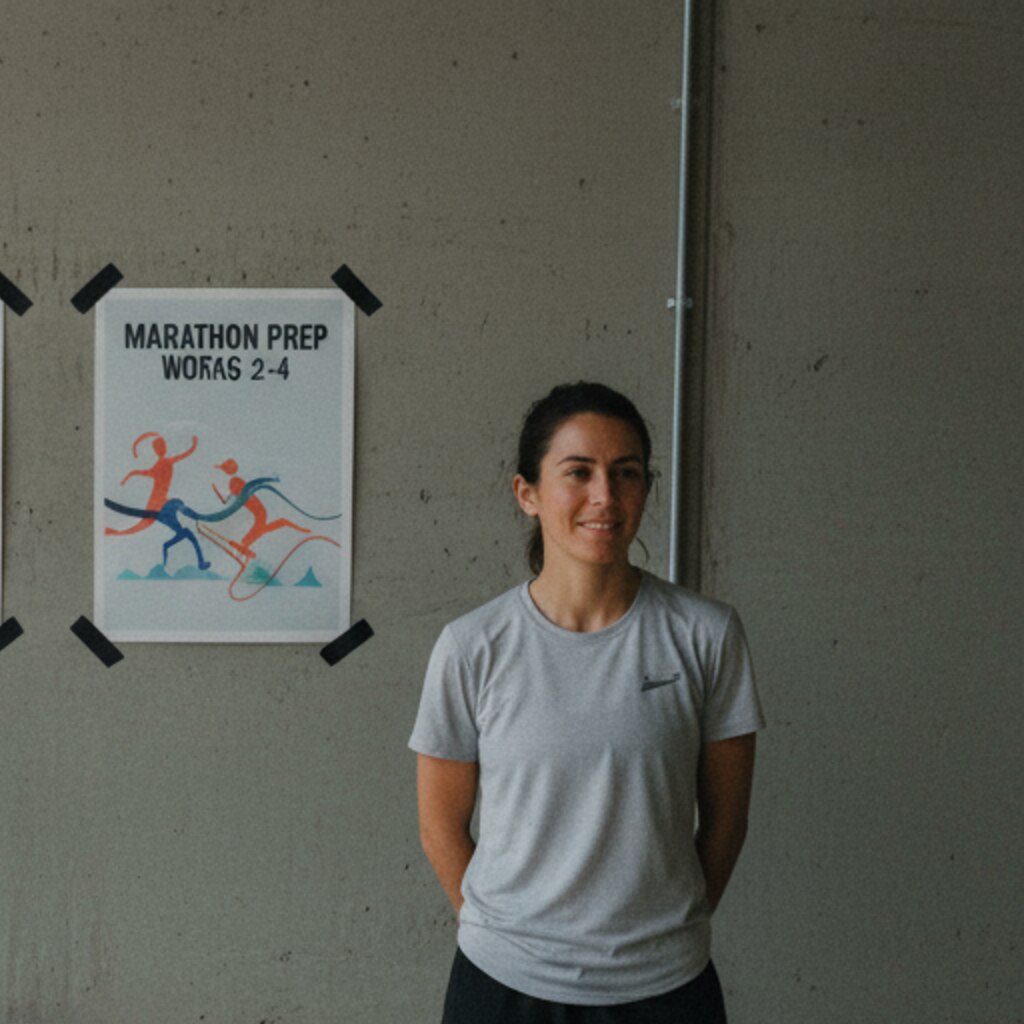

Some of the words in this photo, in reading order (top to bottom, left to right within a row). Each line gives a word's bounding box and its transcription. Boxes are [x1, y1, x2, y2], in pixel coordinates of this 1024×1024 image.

[125, 323, 258, 350] MARATHON
[267, 324, 328, 350] PREP
[251, 356, 290, 381] 2-4
